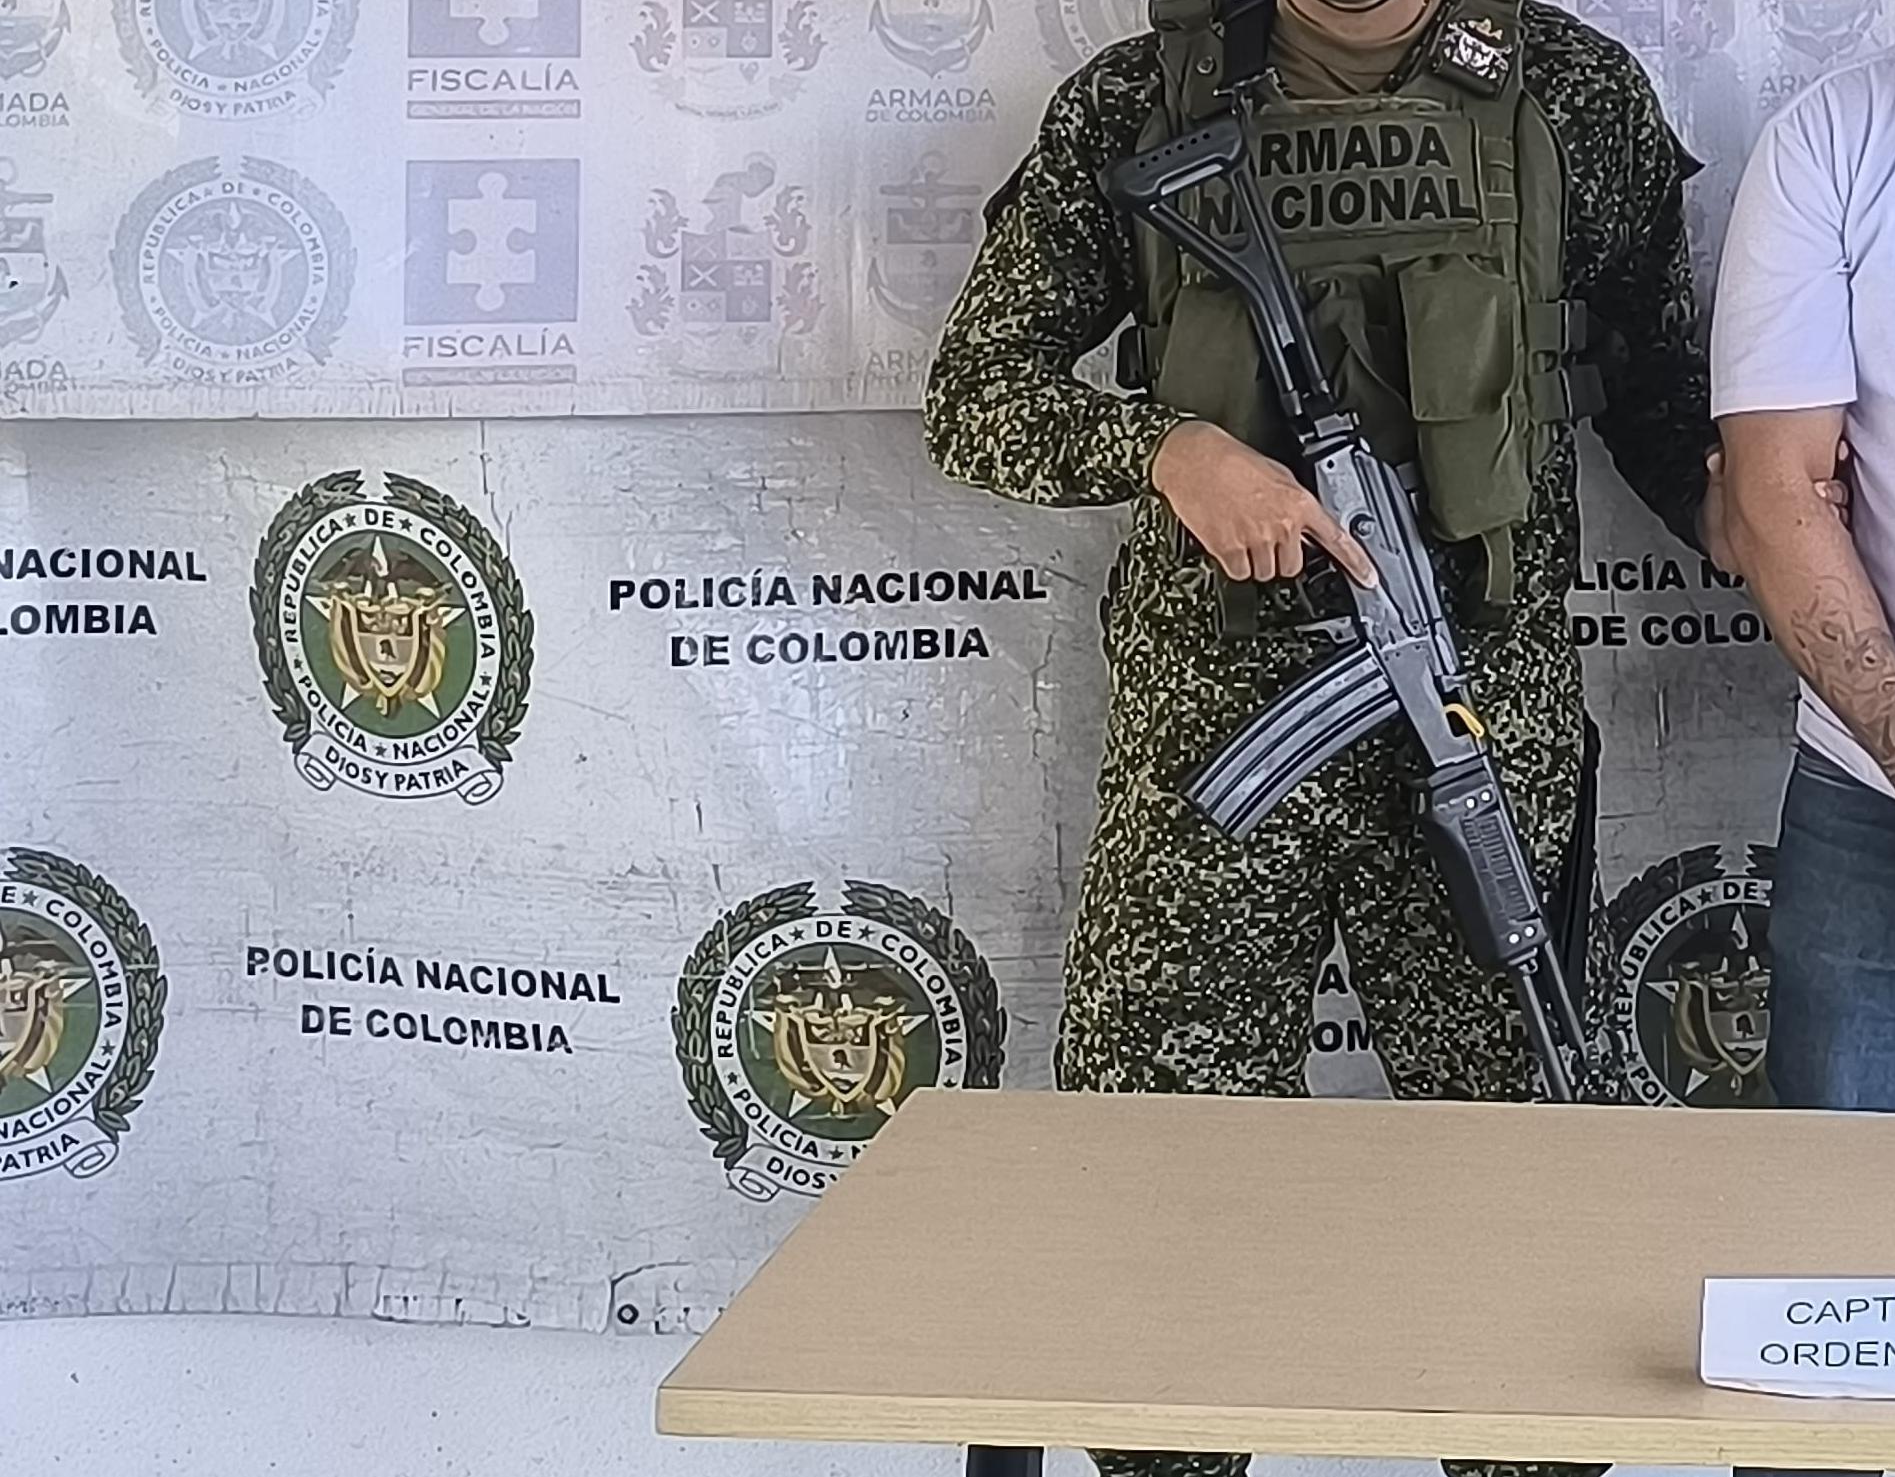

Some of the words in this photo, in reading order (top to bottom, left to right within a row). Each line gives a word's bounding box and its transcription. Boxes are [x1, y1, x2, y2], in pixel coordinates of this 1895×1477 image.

[1199, 177, 1479, 235] NCIONAL
[364, 508, 395, 529] DE
[419, 527, 496, 660] COLOMBIA
[608, 564, 792, 611] POLICÍA
[811, 568, 1047, 607] NACIONAL
[670, 632, 730, 667] DE
[746, 627, 989, 666] COLOMBIA
[1572, 615, 1628, 646] DE
[393, 683, 489, 760] NACIONAL
[395, 758, 469, 792] PATRIA
[1724, 881, 1759, 900] DE
[46, 899, 124, 1029] COLOMBIA
[246, 946, 402, 988] POLICÍA
[415, 960, 621, 1004] NACIONAL
[816, 921, 853, 939] DE
[881, 933, 963, 1066] COLOMBIA
[301, 1004, 353, 1038] DE
[367, 1009, 573, 1054] COLOMBIA
